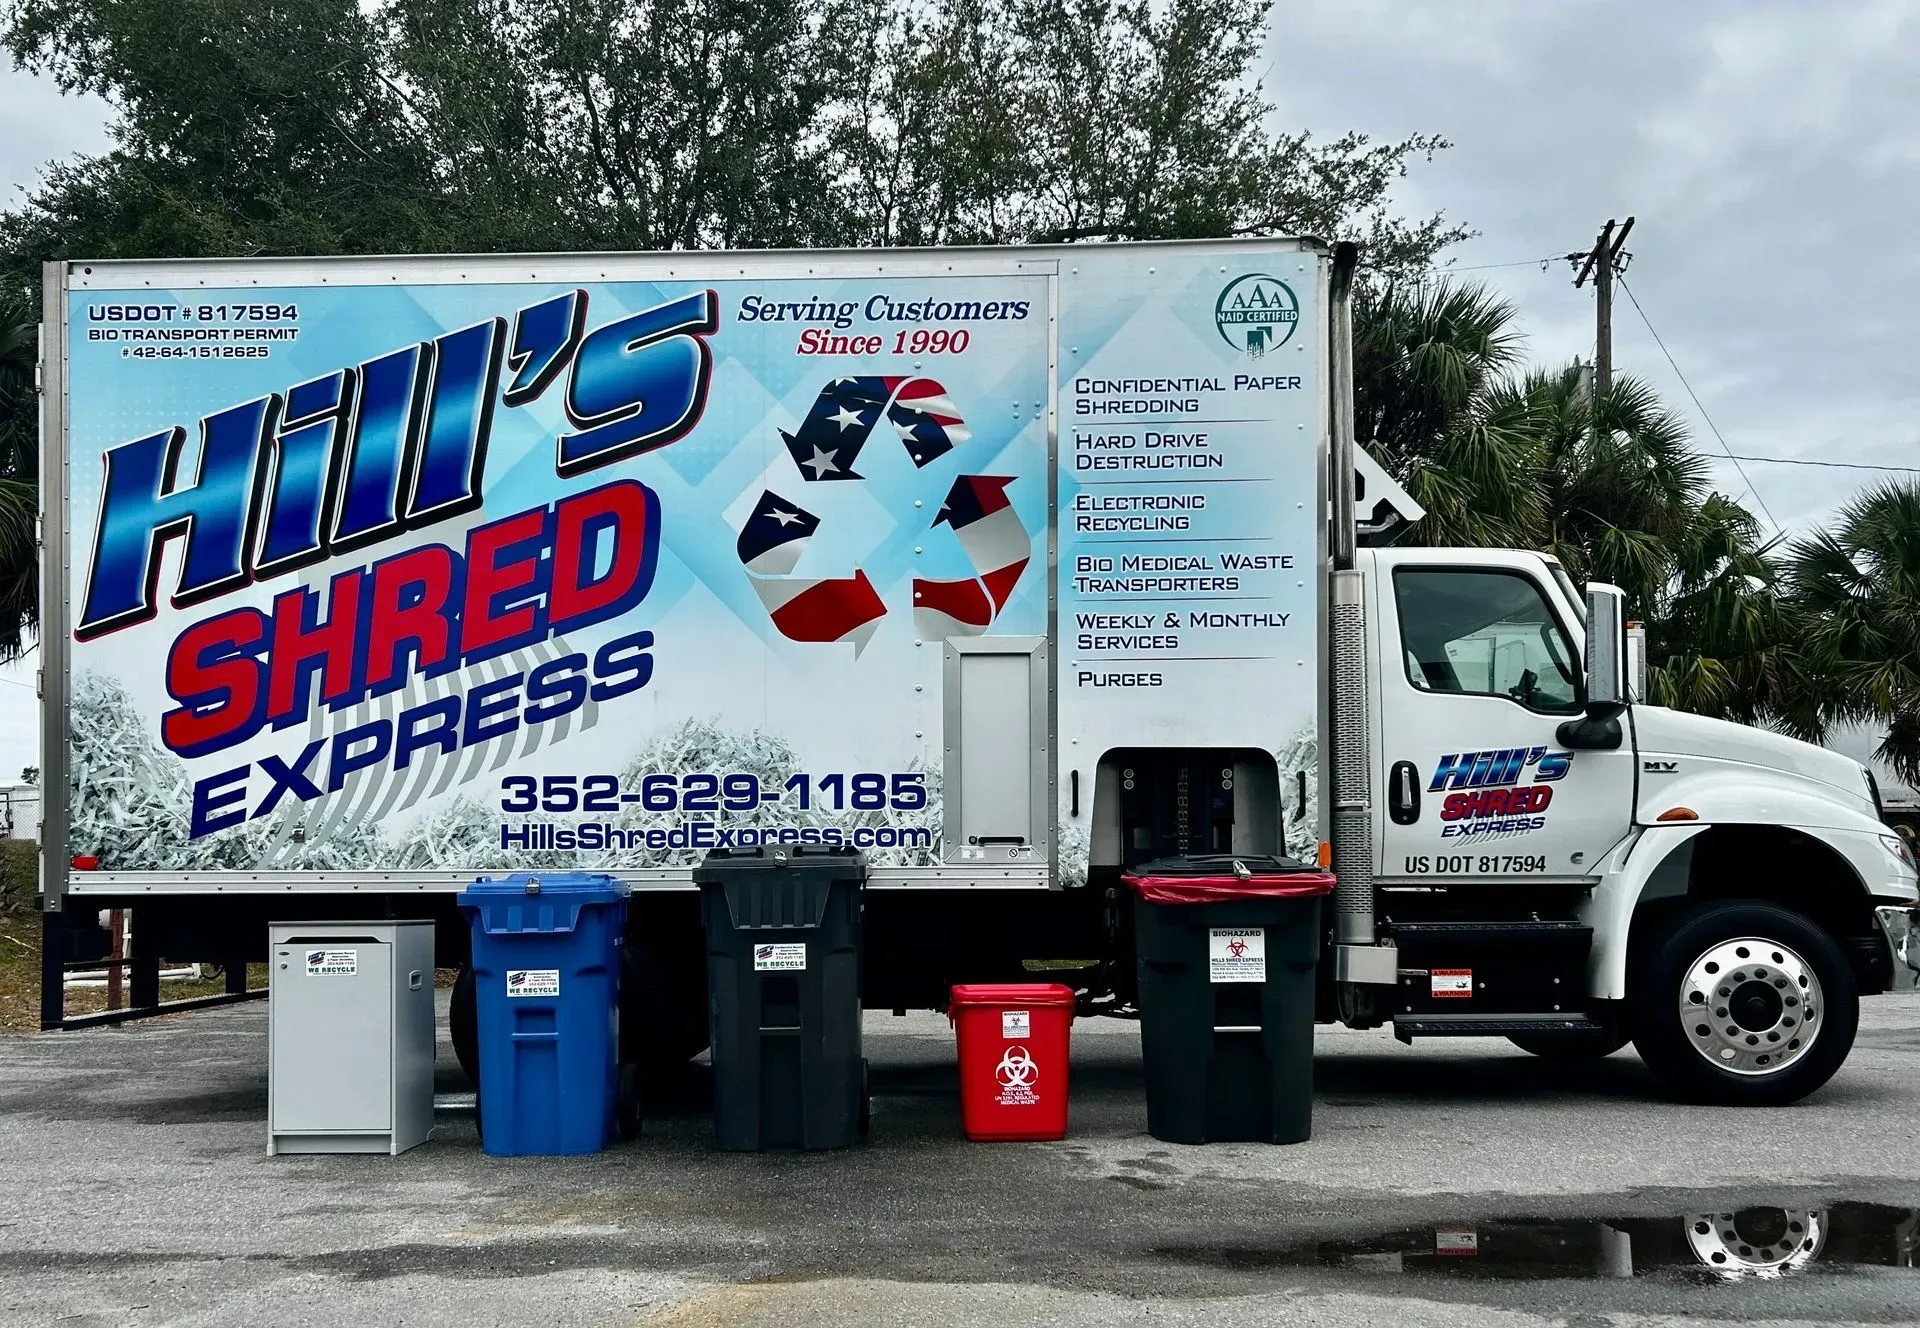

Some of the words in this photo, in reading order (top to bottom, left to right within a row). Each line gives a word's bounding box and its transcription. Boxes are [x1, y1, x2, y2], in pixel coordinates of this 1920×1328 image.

[1231, 284, 1284, 309] AAA
[88, 305, 177, 321] USDOT
[182, 307, 192, 320] #
[198, 304, 298, 321] 817594
[738, 295, 858, 328] Serving
[864, 294, 1030, 321] Customers
[1217, 312, 1244, 322] NAID
[1246, 311, 1298, 322] CERTIFIED
[88, 329, 119, 341] BIO
[122, 328, 230, 341] TRANSPORT
[233, 328, 299, 340] PERMIT
[797, 328, 883, 355] Since
[891, 329, 970, 355] 1990
[122, 348, 130, 358] #
[133, 346, 269, 358] 42-64-1512625
[1075, 378, 1226, 394] CONFIDENTIAL
[1234, 374, 1302, 391] PAPER
[1075, 398, 1199, 415] SHREDDING
[1076, 433, 1136, 450] HARD
[1144, 432, 1208, 448] DRIVE
[74, 289, 718, 642] Hill's
[1076, 454, 1224, 470] DESTRUCTION
[1076, 495, 1206, 511] ELECTRONIC
[1076, 516, 1190, 532] RECYCLING
[1076, 556, 1113, 572] BIO
[1122, 555, 1214, 572] MEDICAL
[1220, 554, 1294, 570] WASTE
[1075, 576, 1240, 592] TRANSPORTERS
[160, 478, 662, 759] SHRED
[1076, 613, 1156, 630] WEEKLY
[1164, 612, 1180, 628] &
[1190, 612, 1291, 628] MONTHLY
[1078, 634, 1178, 650] SERVICES
[1078, 672, 1162, 687] PURGES
[190, 630, 654, 840] EXPRESS
[1427, 745, 1575, 793] Hill's
[1643, 761, 1679, 771] MV
[501, 773, 927, 812] 352-629-1185
[1440, 784, 1554, 822] SHRED
[1440, 816, 1546, 838] EXPRESS
[1405, 856, 1430, 874] US
[1436, 856, 1474, 874] DOT
[1478, 855, 1546, 873] 817594
